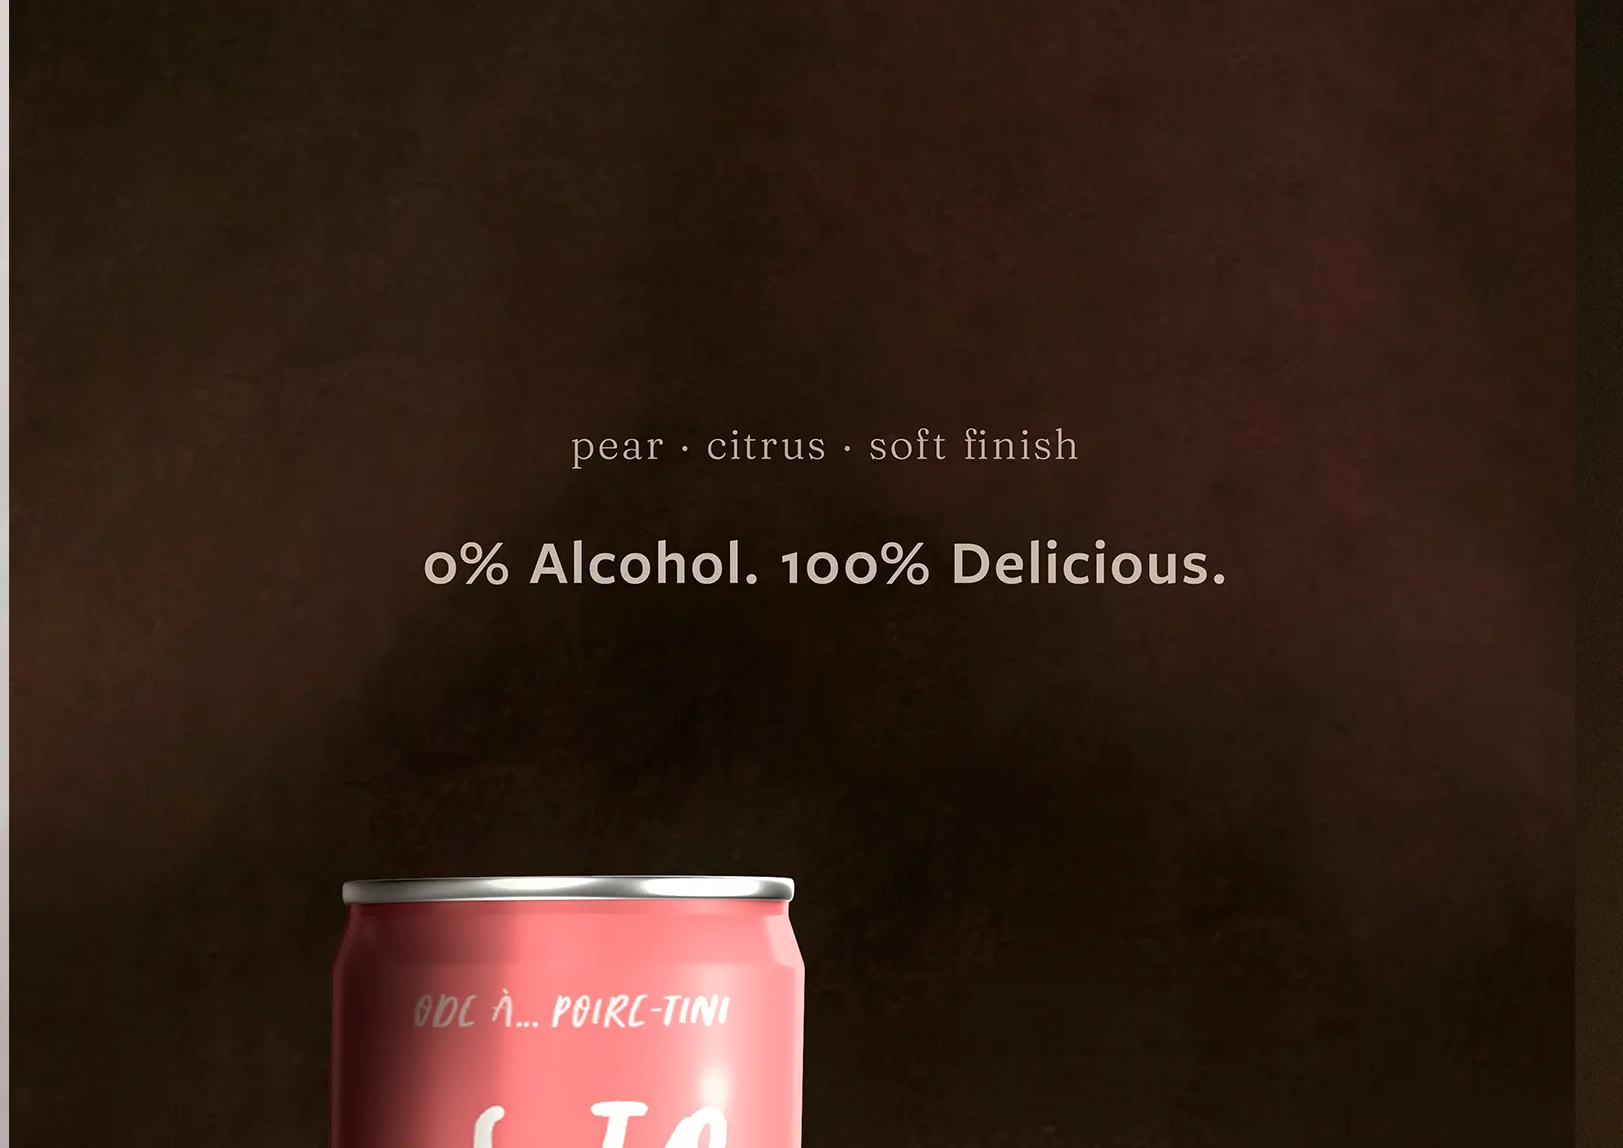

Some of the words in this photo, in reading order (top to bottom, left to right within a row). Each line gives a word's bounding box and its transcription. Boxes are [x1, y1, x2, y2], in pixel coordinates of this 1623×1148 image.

[414, 994, 476, 1028] ODE
[491, 988, 539, 1028] À...
[552, 994, 731, 1029] POIRE-TINI
